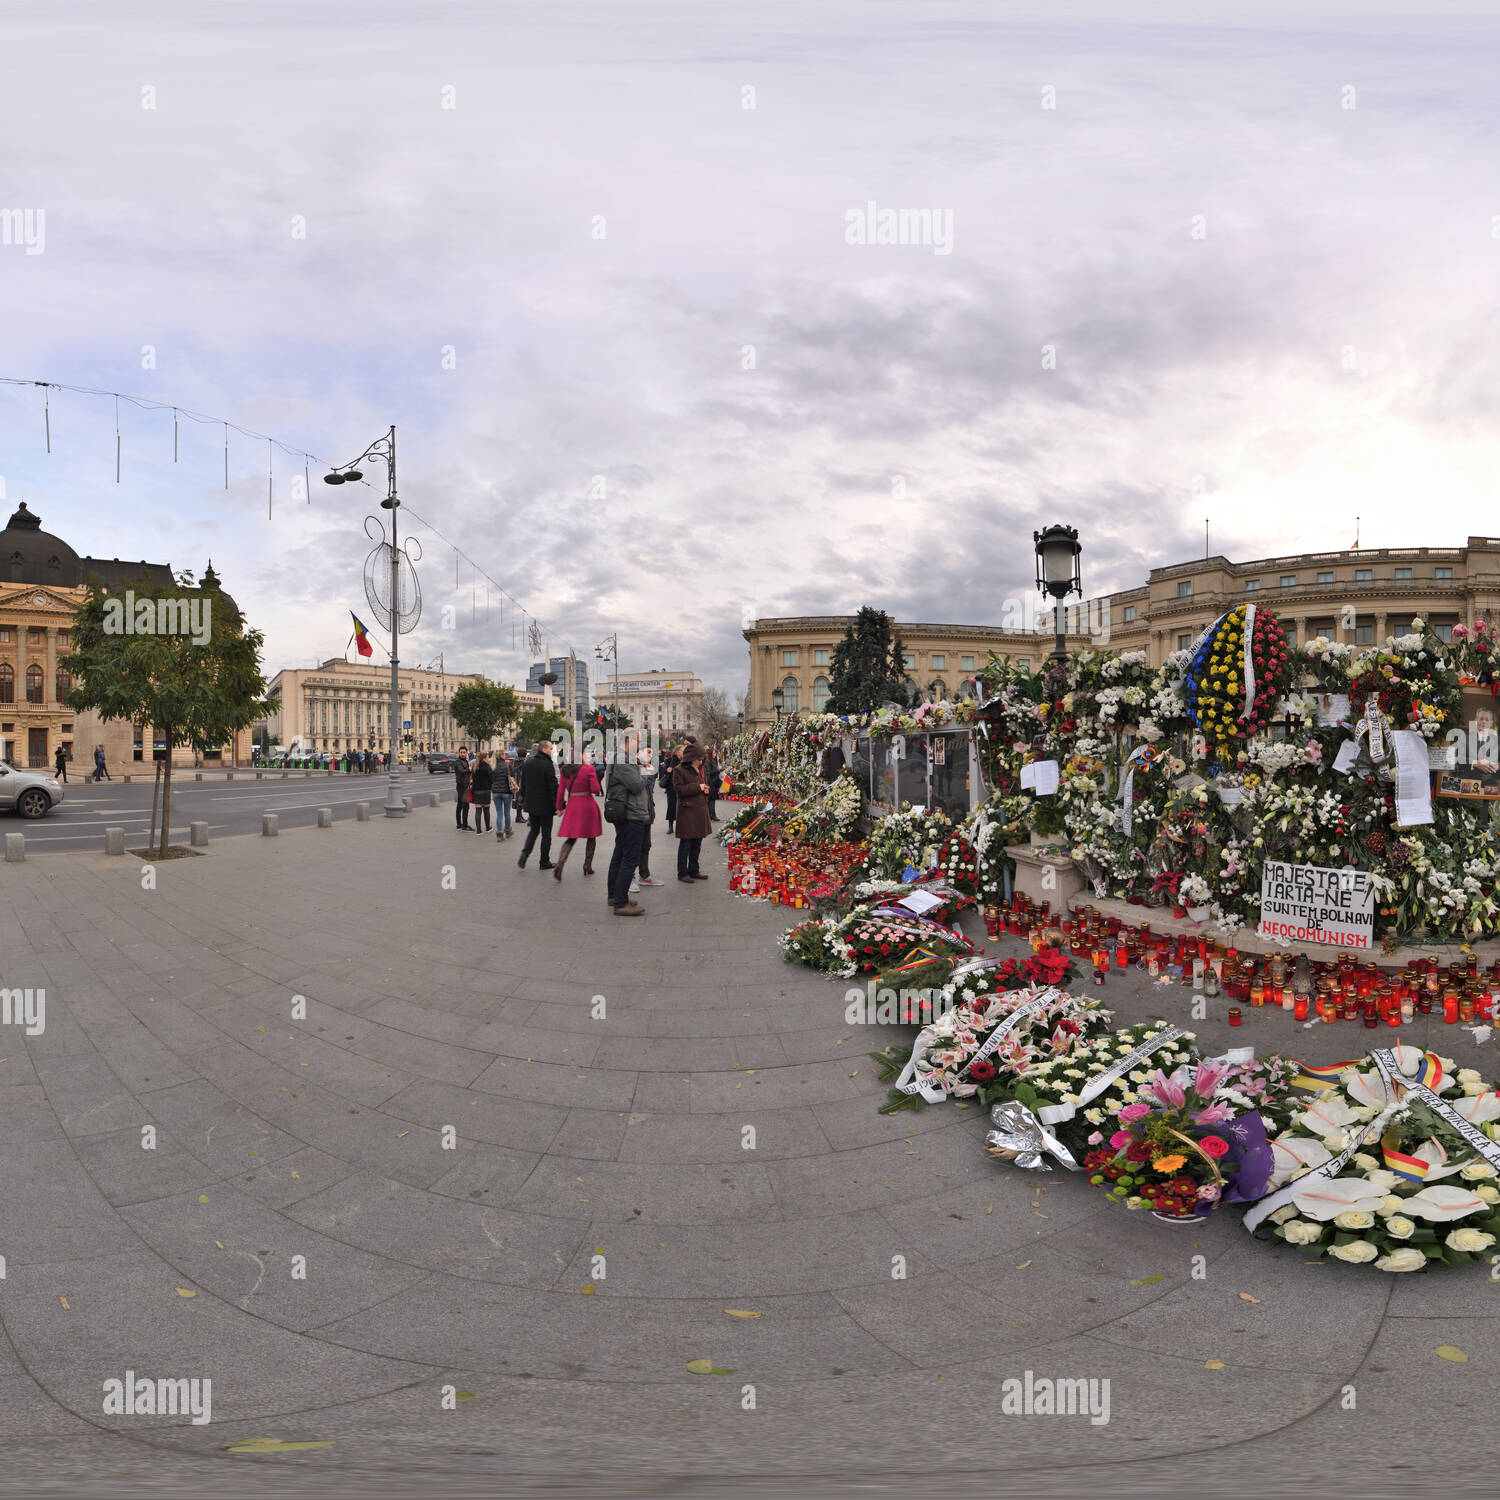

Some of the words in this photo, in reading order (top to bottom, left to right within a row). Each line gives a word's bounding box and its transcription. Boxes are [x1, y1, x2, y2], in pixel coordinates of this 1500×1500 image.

[1264, 901, 1317, 919] SUNTEM
[1320, 909, 1373, 926] BOLNAVI
[1307, 919, 1324, 931] DE
[1262, 920, 1368, 948] NEOCOMUNISM
